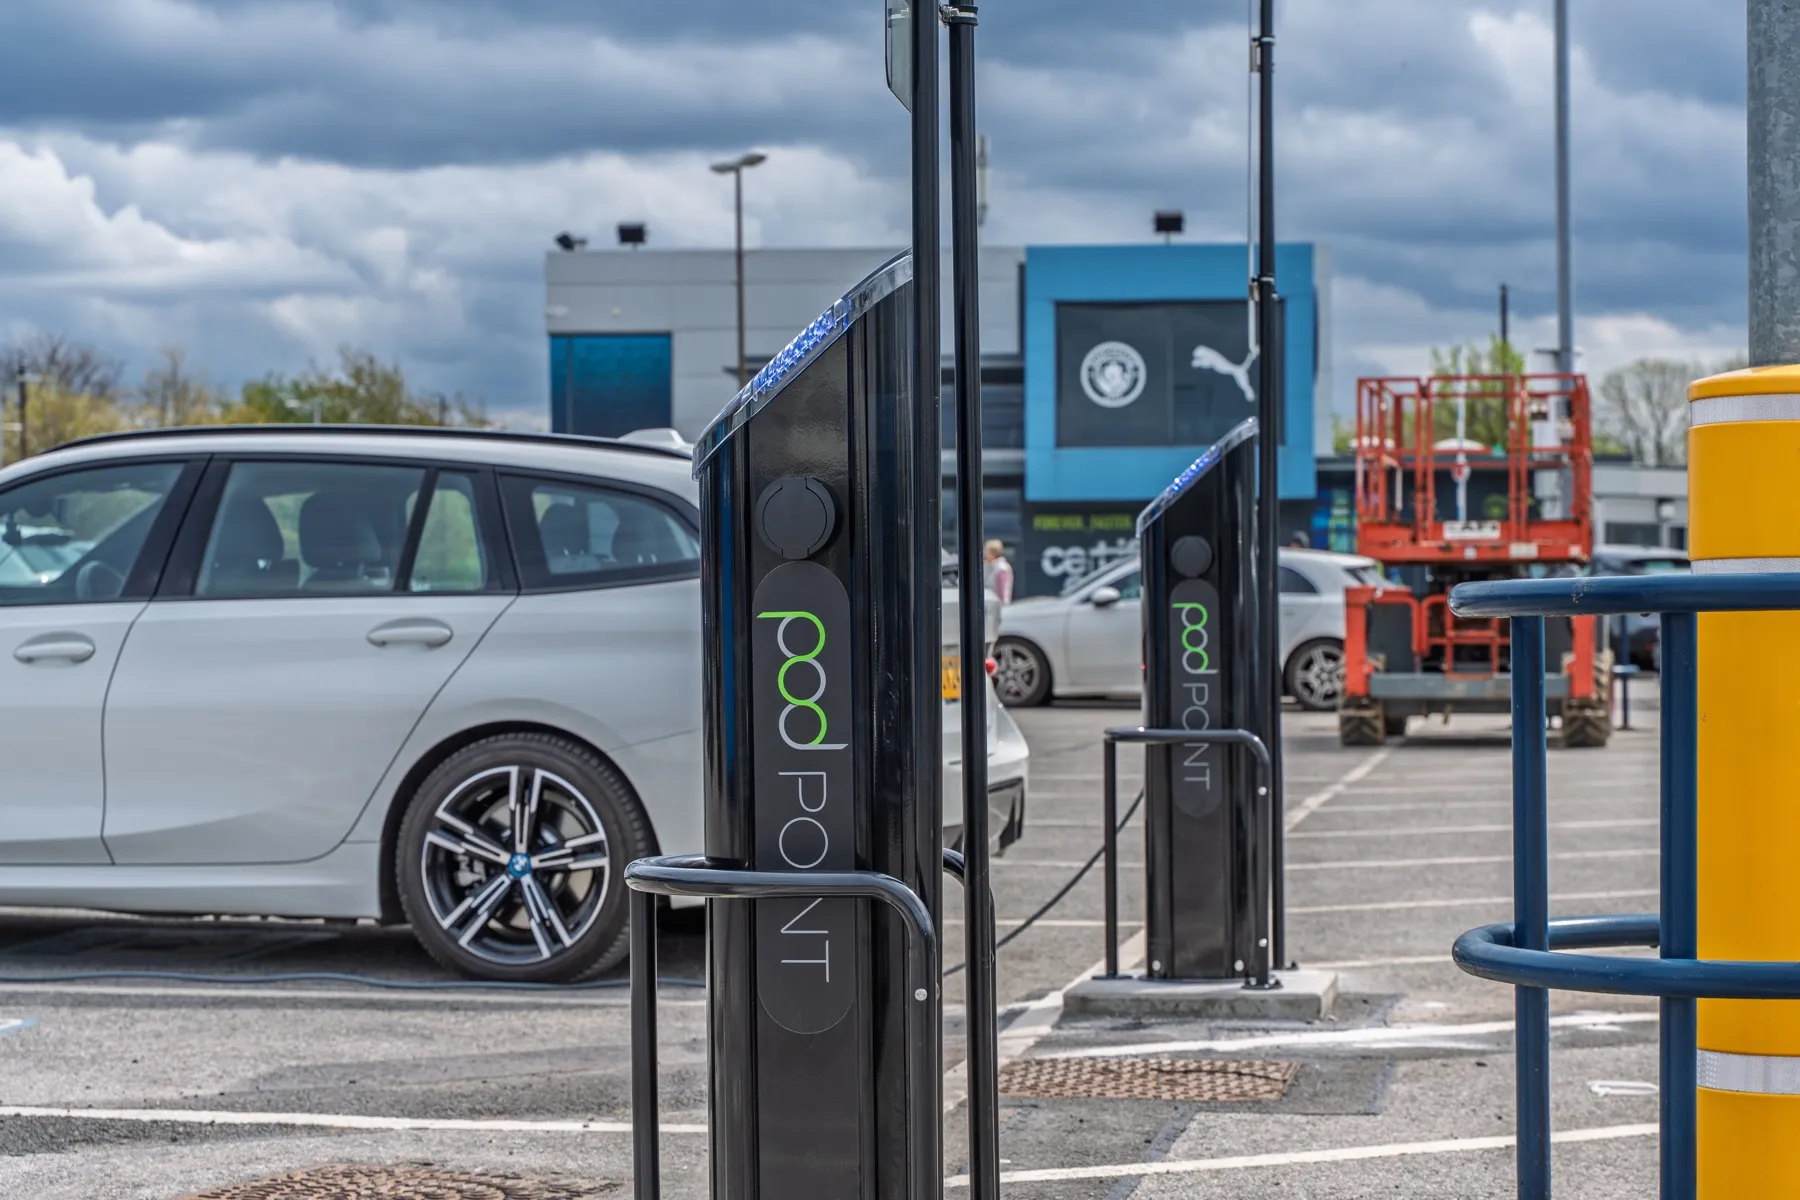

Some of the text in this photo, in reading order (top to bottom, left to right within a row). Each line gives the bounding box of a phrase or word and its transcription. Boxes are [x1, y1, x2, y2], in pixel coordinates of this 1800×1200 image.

[756, 611, 849, 983] pod PONT
[1172, 603, 1218, 790] pod PONT
